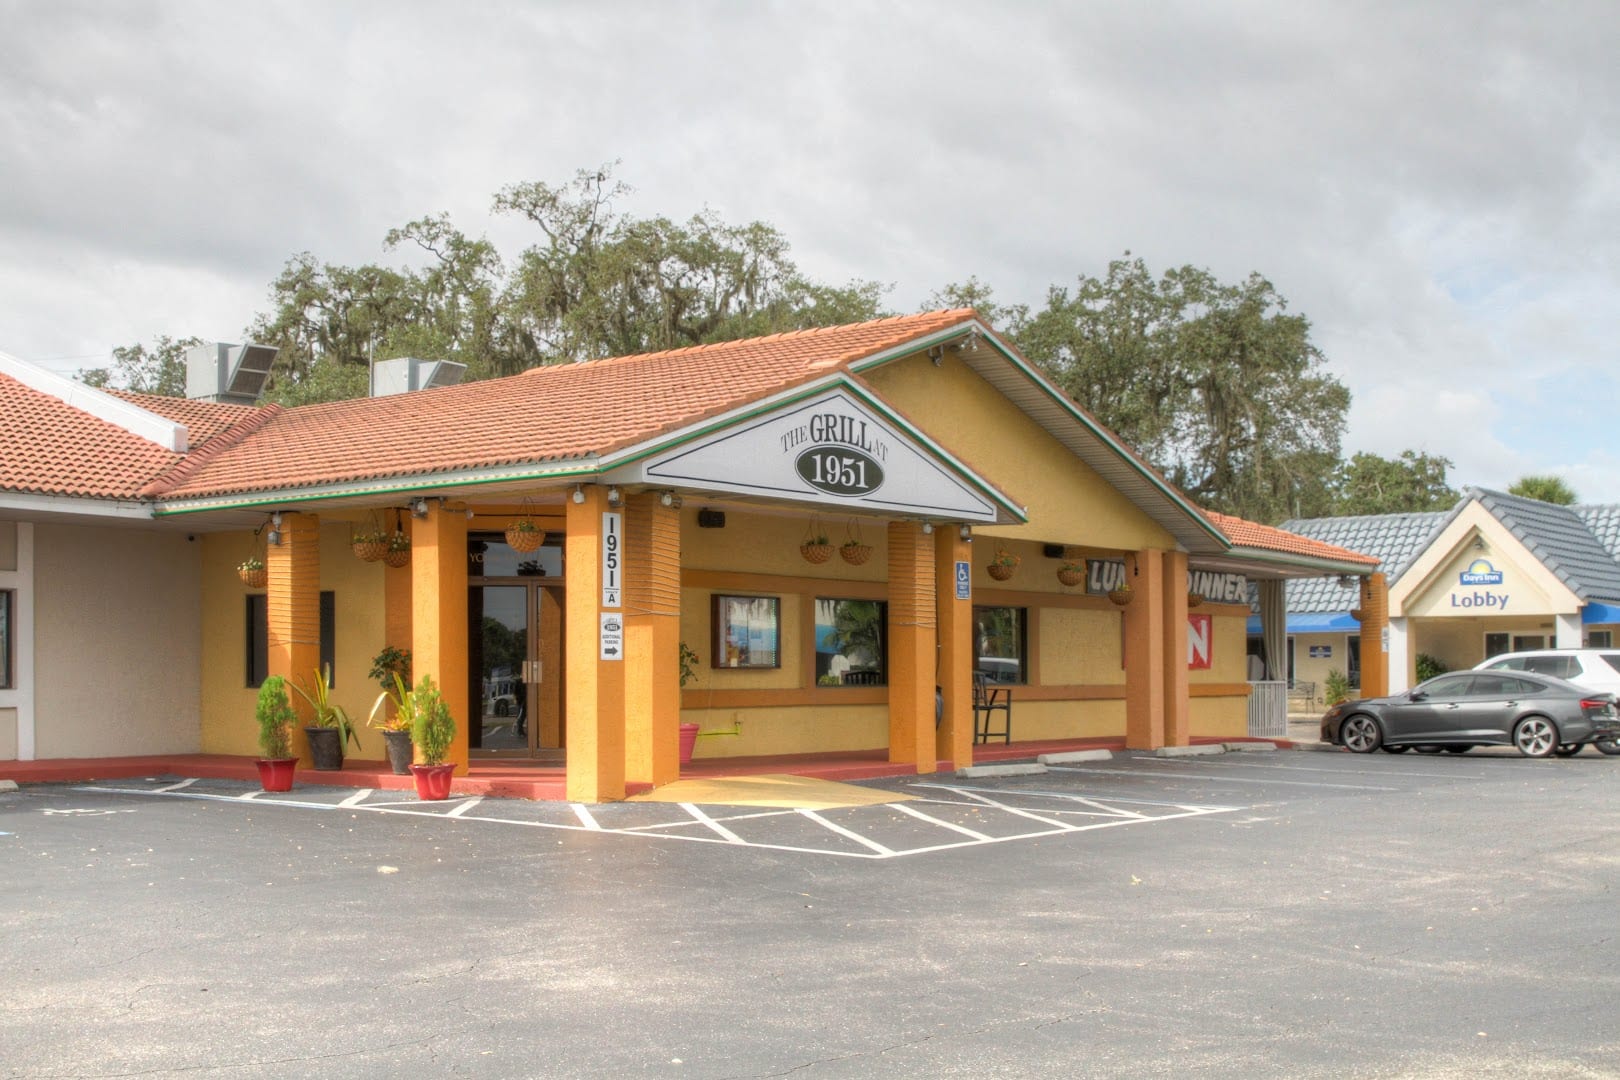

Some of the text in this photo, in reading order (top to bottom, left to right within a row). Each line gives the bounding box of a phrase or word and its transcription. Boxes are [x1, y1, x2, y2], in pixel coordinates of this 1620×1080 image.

[781, 413, 888, 461] THE GRILL AT
[811, 453, 869, 489] 1951
[607, 517, 617, 587] 1951
[1463, 574, 1483, 582] Days
[608, 593, 616, 603] A
[1451, 591, 1509, 610] Lobby
